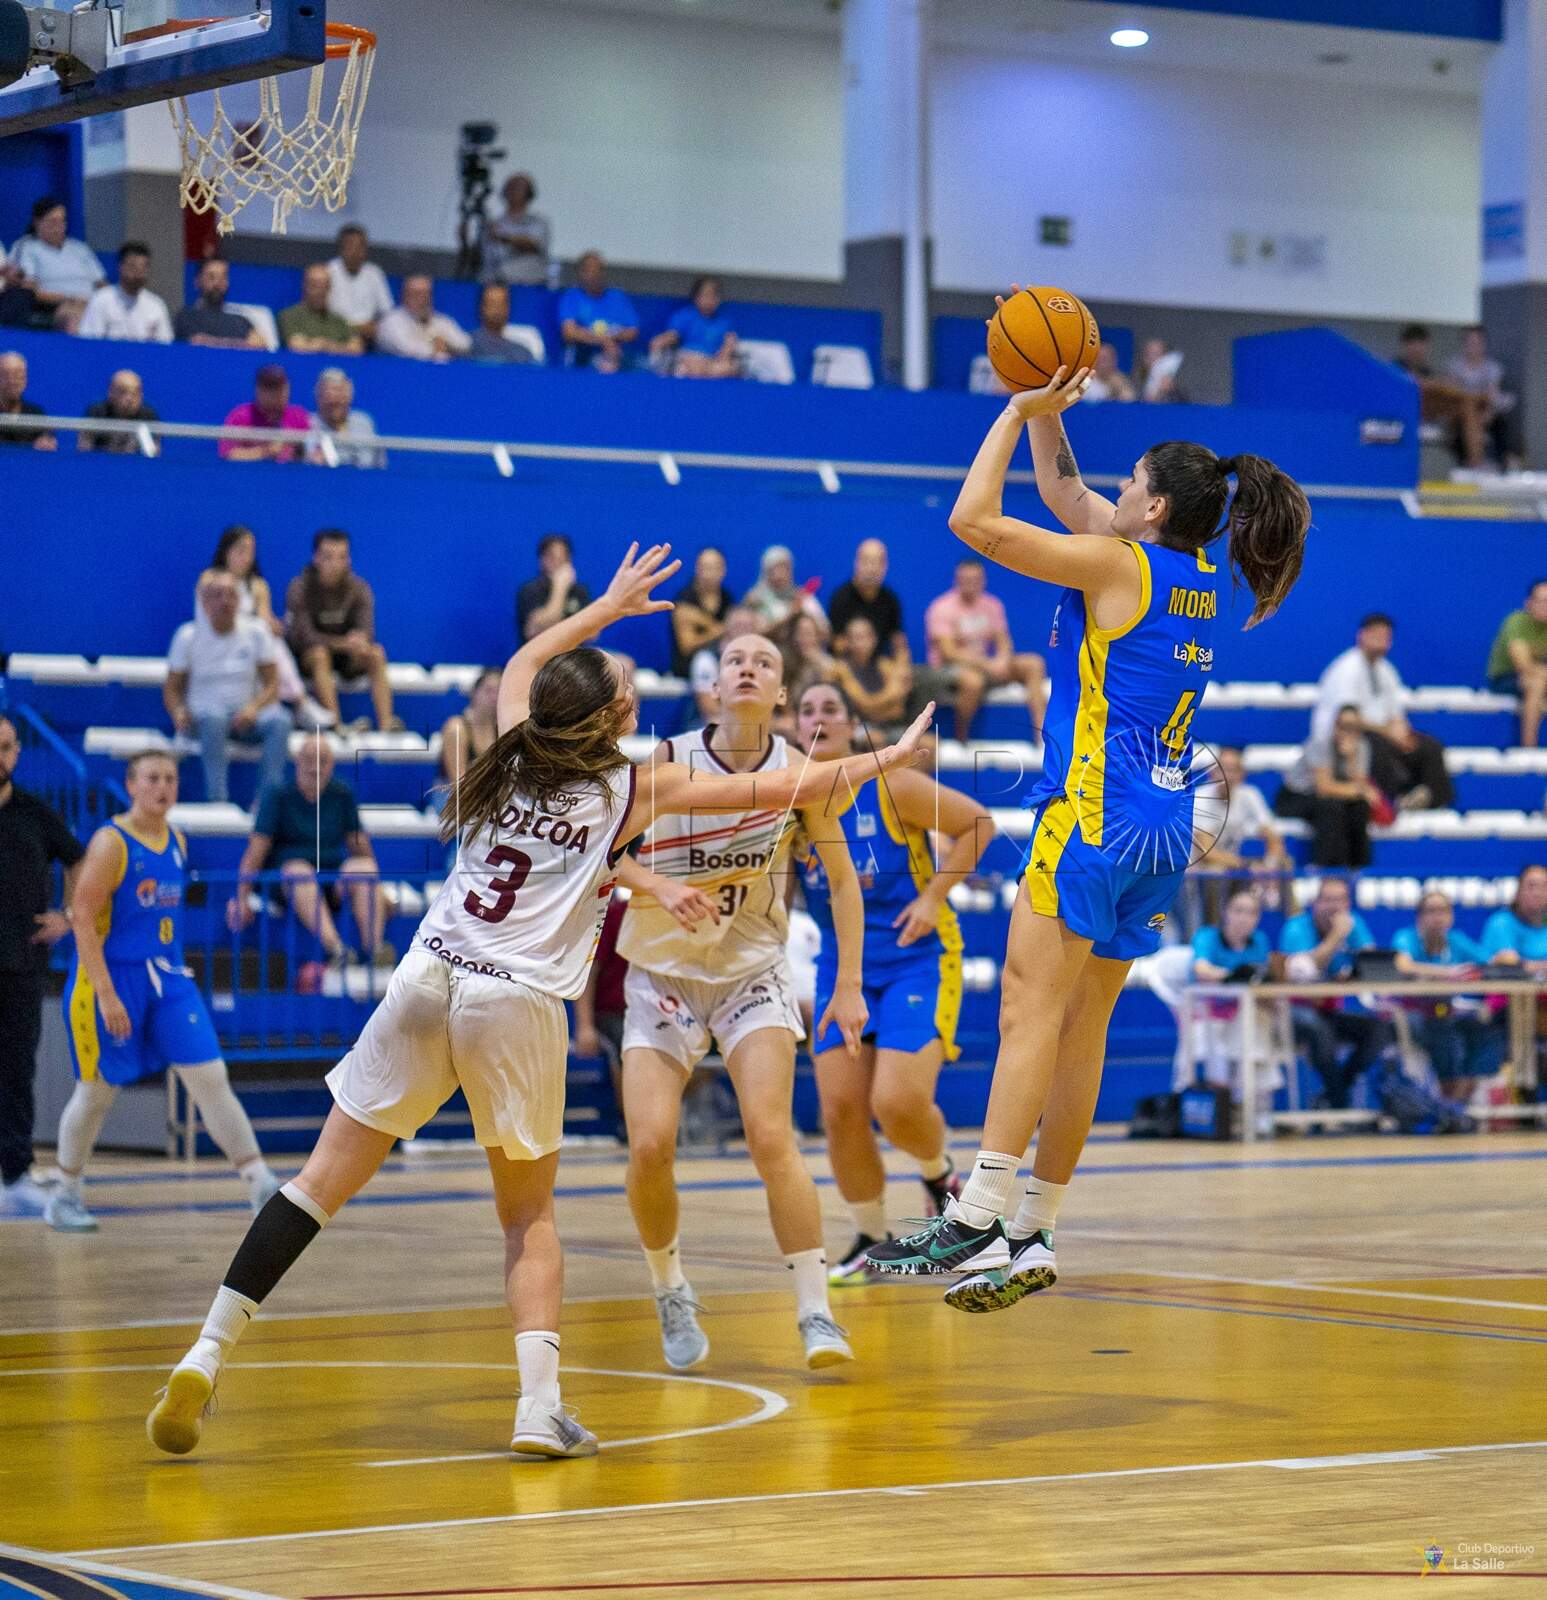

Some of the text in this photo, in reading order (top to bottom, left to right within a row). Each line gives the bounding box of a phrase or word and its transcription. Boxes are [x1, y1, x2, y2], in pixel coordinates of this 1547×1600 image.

[1173, 644, 1188, 661] La
[488, 803, 591, 853] DECOA
[690, 848, 776, 870] Boson
[463, 844, 532, 923] 3
[424, 936, 512, 980] OGROÑO
